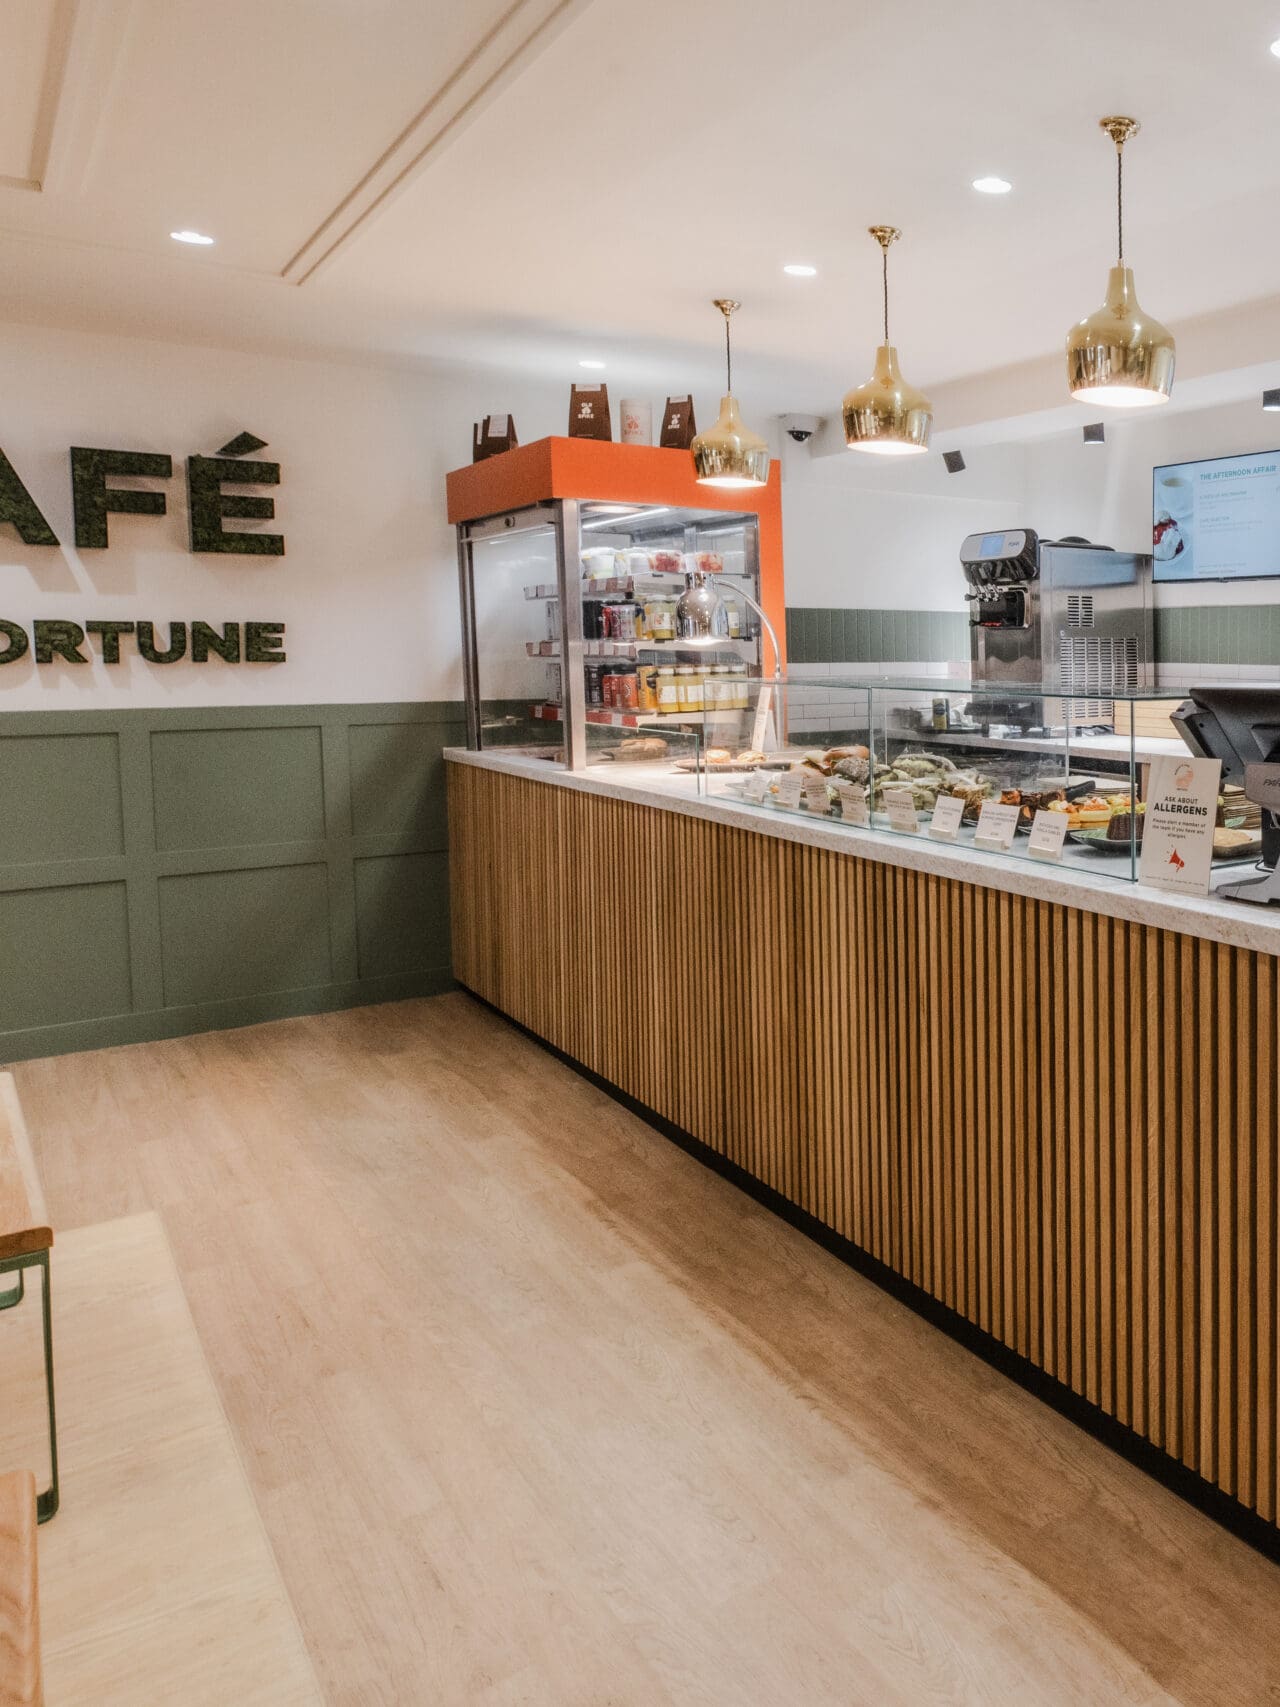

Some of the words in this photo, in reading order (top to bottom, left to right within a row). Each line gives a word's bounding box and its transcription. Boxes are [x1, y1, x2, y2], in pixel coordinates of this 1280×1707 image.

[1200, 473, 1212, 481] THE
[1212, 468, 1252, 480] AFTERNOON
[1252, 464, 1277, 475] AFFAIR
[0, 618, 287, 664] ORTUNE
[1177, 797, 1199, 805] ABOUT
[1153, 802, 1208, 816] ALLERGENS
